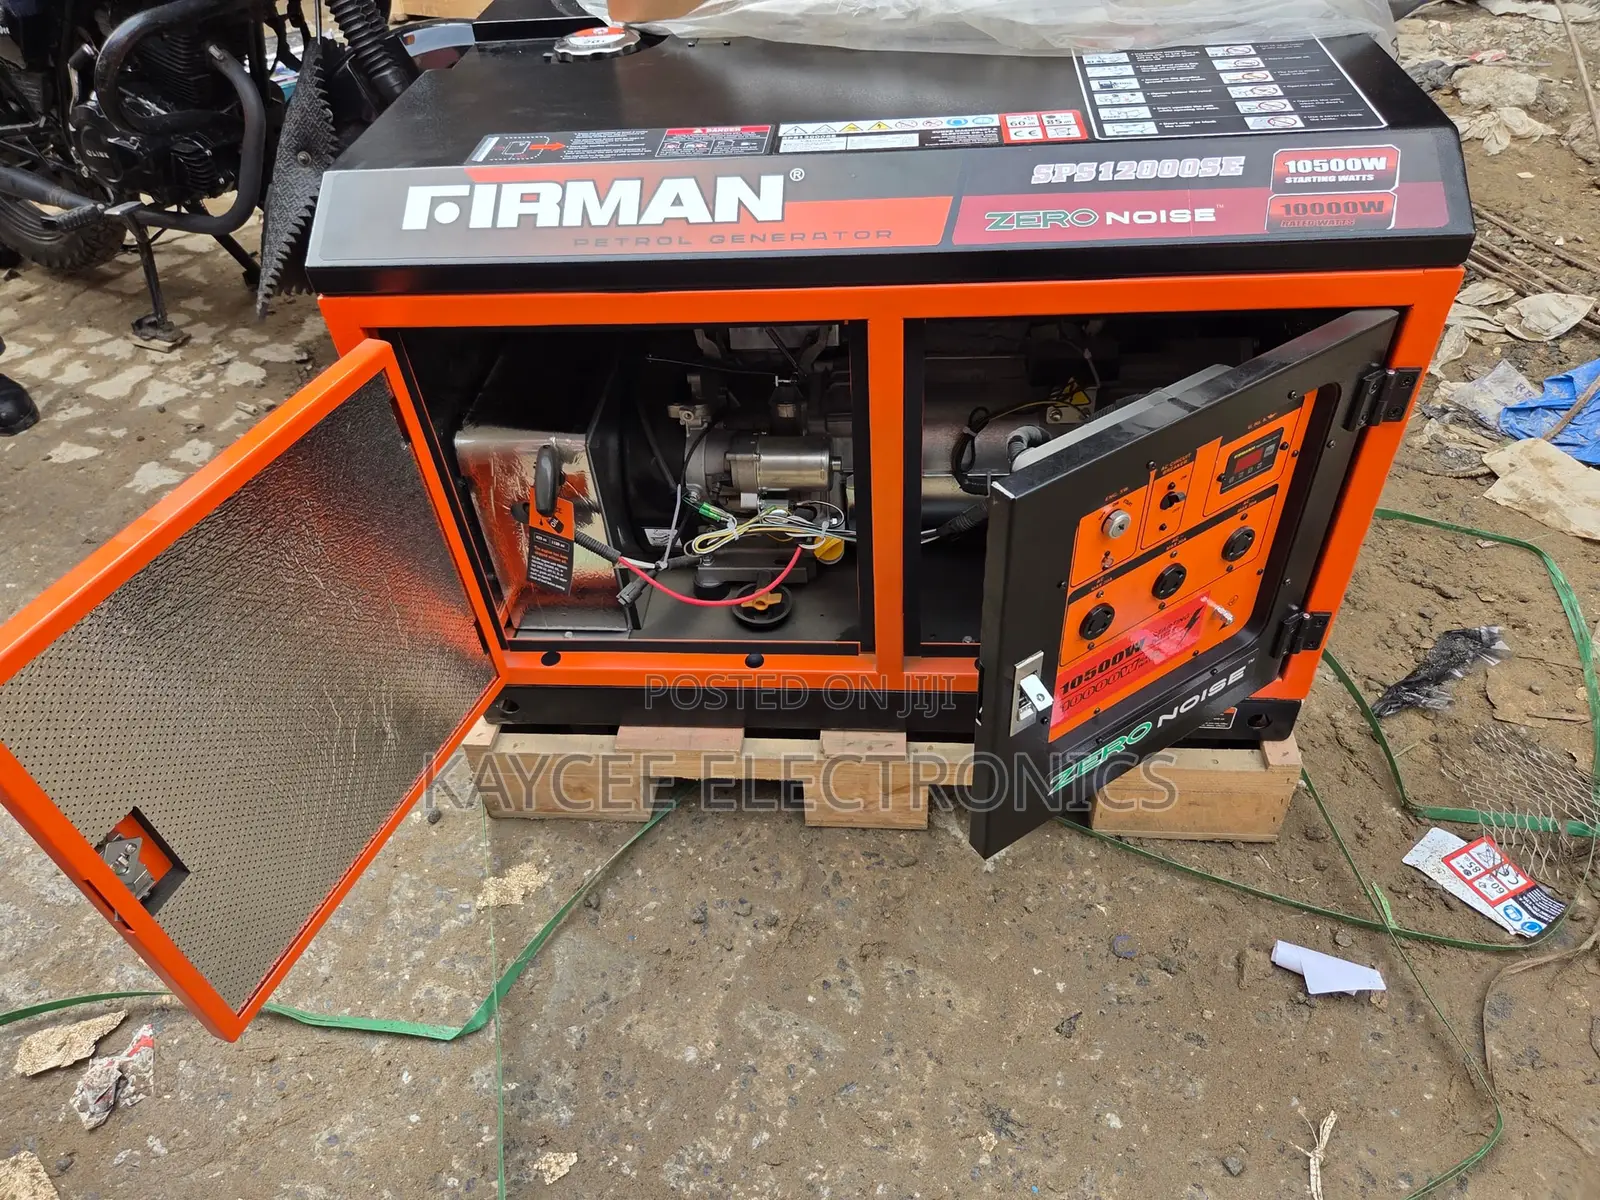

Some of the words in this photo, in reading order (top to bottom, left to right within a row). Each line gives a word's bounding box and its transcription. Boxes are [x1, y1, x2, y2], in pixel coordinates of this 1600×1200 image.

[1031, 155, 1246, 184] SPS12000SE
[1284, 156, 1387, 174] 10500W
[1284, 174, 1337, 184] STARTING
[1338, 174, 1374, 182] WATTS
[402, 174, 785, 230] FIRMAN
[1280, 200, 1384, 216] 10000W
[985, 208, 1098, 232] ZERO
[1106, 208, 1216, 226] NOISE
[1280, 218, 1314, 228] RATED
[1315, 218, 1356, 227] WATTS
[573, 236, 692, 248] PETROL
[710, 229, 894, 244] GENERATOR
[1061, 637, 1146, 696] 10500W
[1060, 658, 1140, 712] 10000W
[1048, 722, 1152, 796] ZERO
[1157, 666, 1246, 728] NOISE
